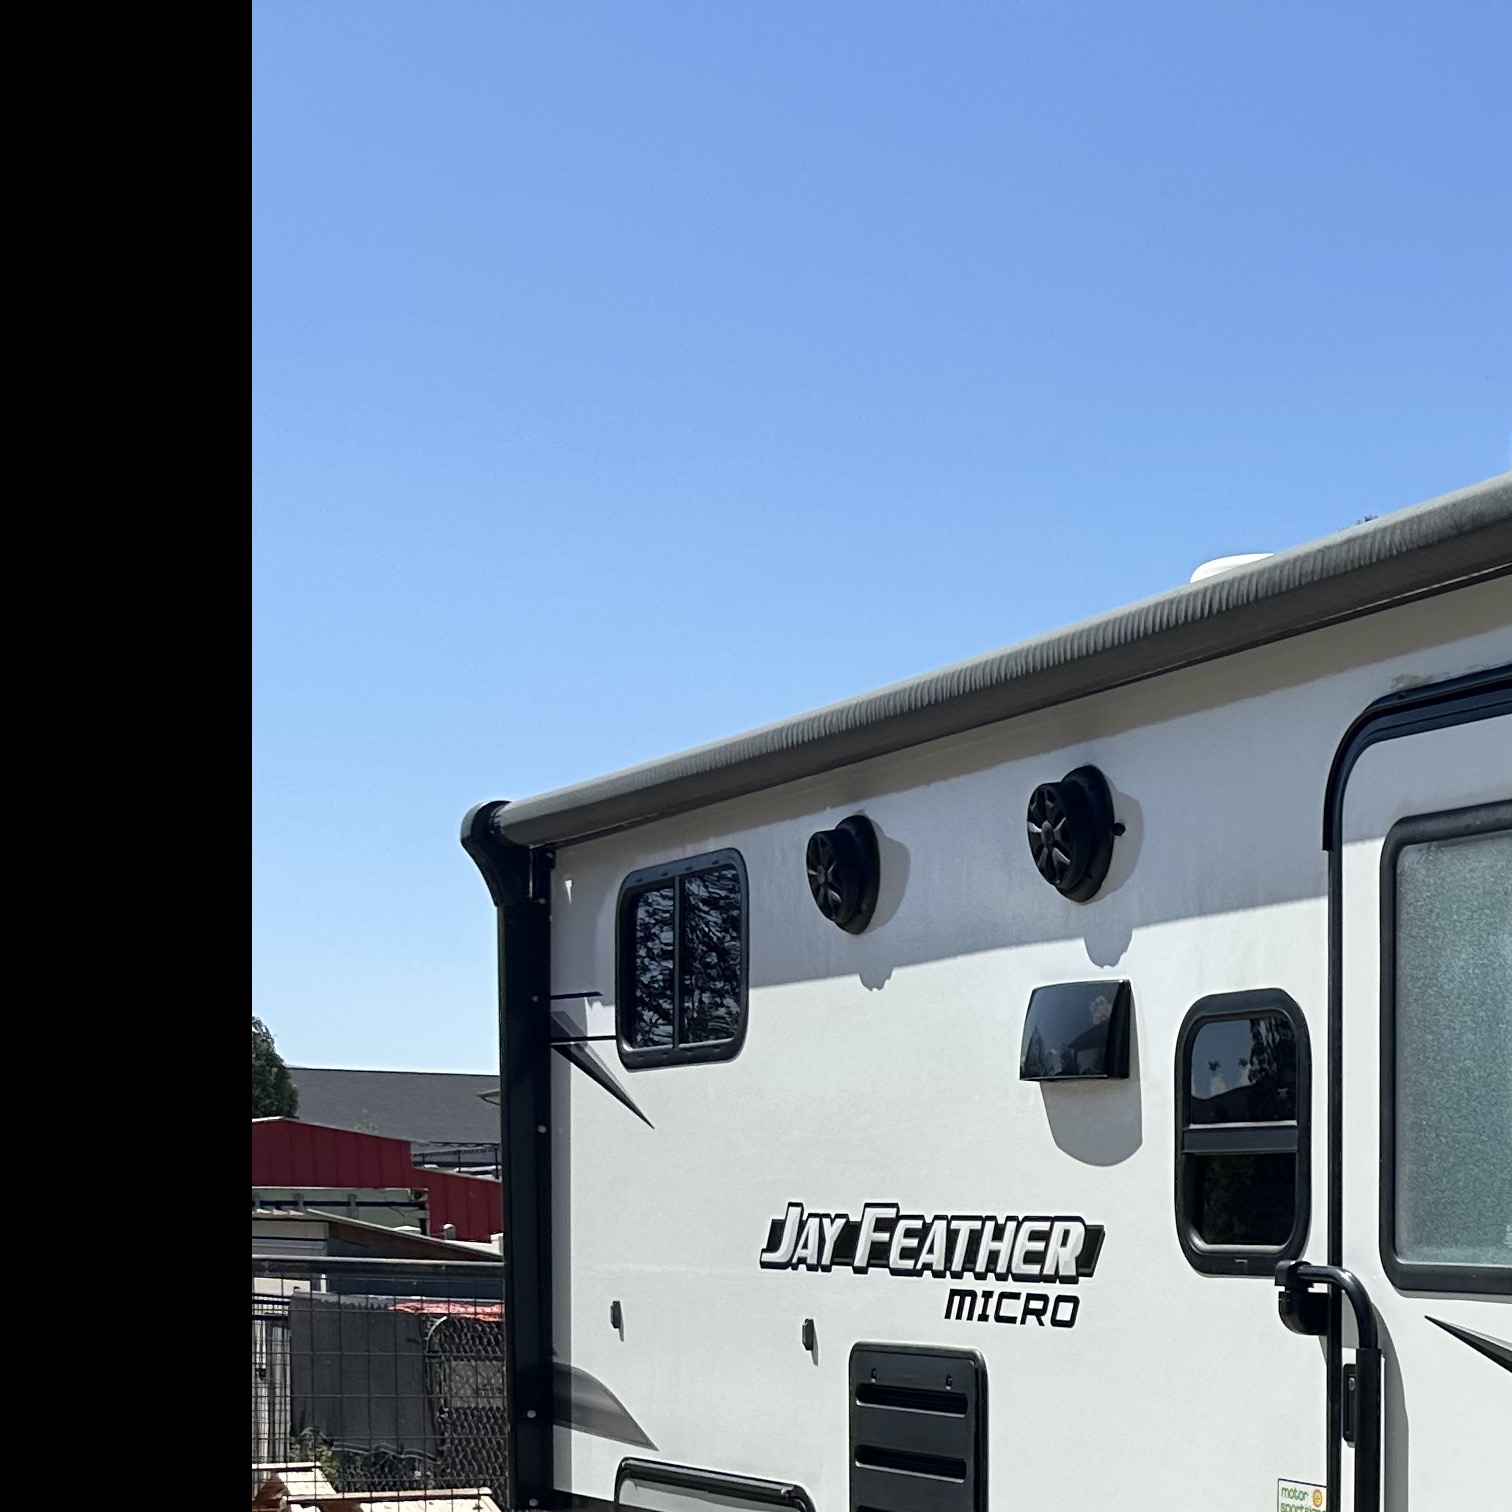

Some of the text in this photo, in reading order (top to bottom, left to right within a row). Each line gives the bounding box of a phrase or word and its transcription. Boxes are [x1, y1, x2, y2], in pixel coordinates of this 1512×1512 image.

[760, 1201, 1087, 1285] JAY FEATHER
[944, 1288, 1081, 1329] MICRO
